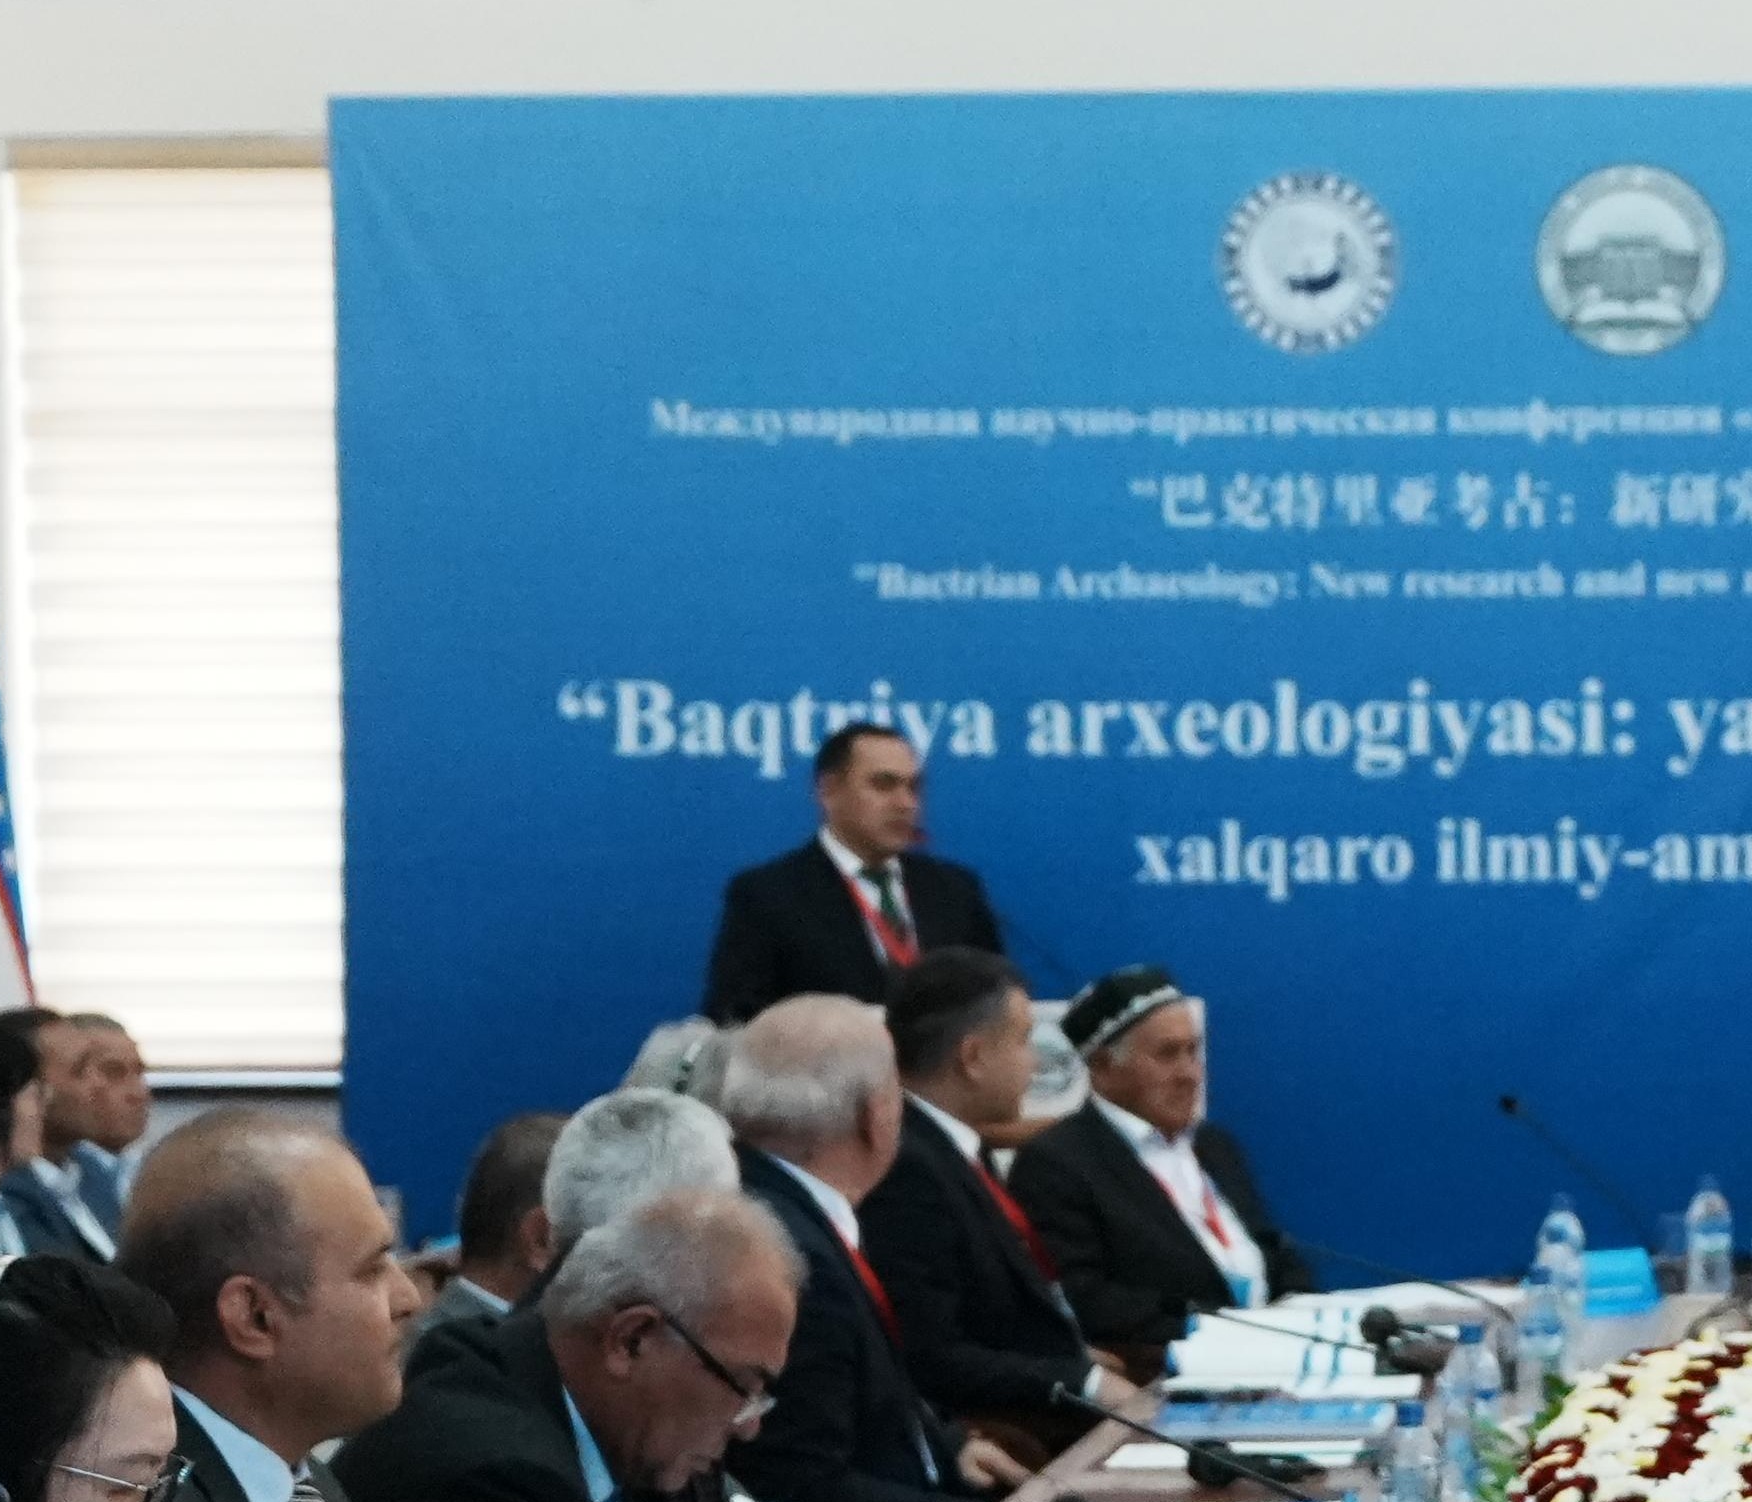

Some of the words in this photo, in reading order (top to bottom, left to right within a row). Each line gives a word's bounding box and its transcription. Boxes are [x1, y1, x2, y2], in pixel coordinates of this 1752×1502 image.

[650, 399, 981, 446] Международная
[990, 407, 1437, 445] научно-практическая
[1051, 563, 1297, 607] Archaeology:
[1309, 563, 1391, 599] New
[1402, 563, 1565, 599] research
[1573, 562, 1647, 599] and
[1655, 570, 1731, 598] new
[1025, 676, 1636, 778] arxeologiyasi:
[1135, 818, 1415, 903] xalqaro
